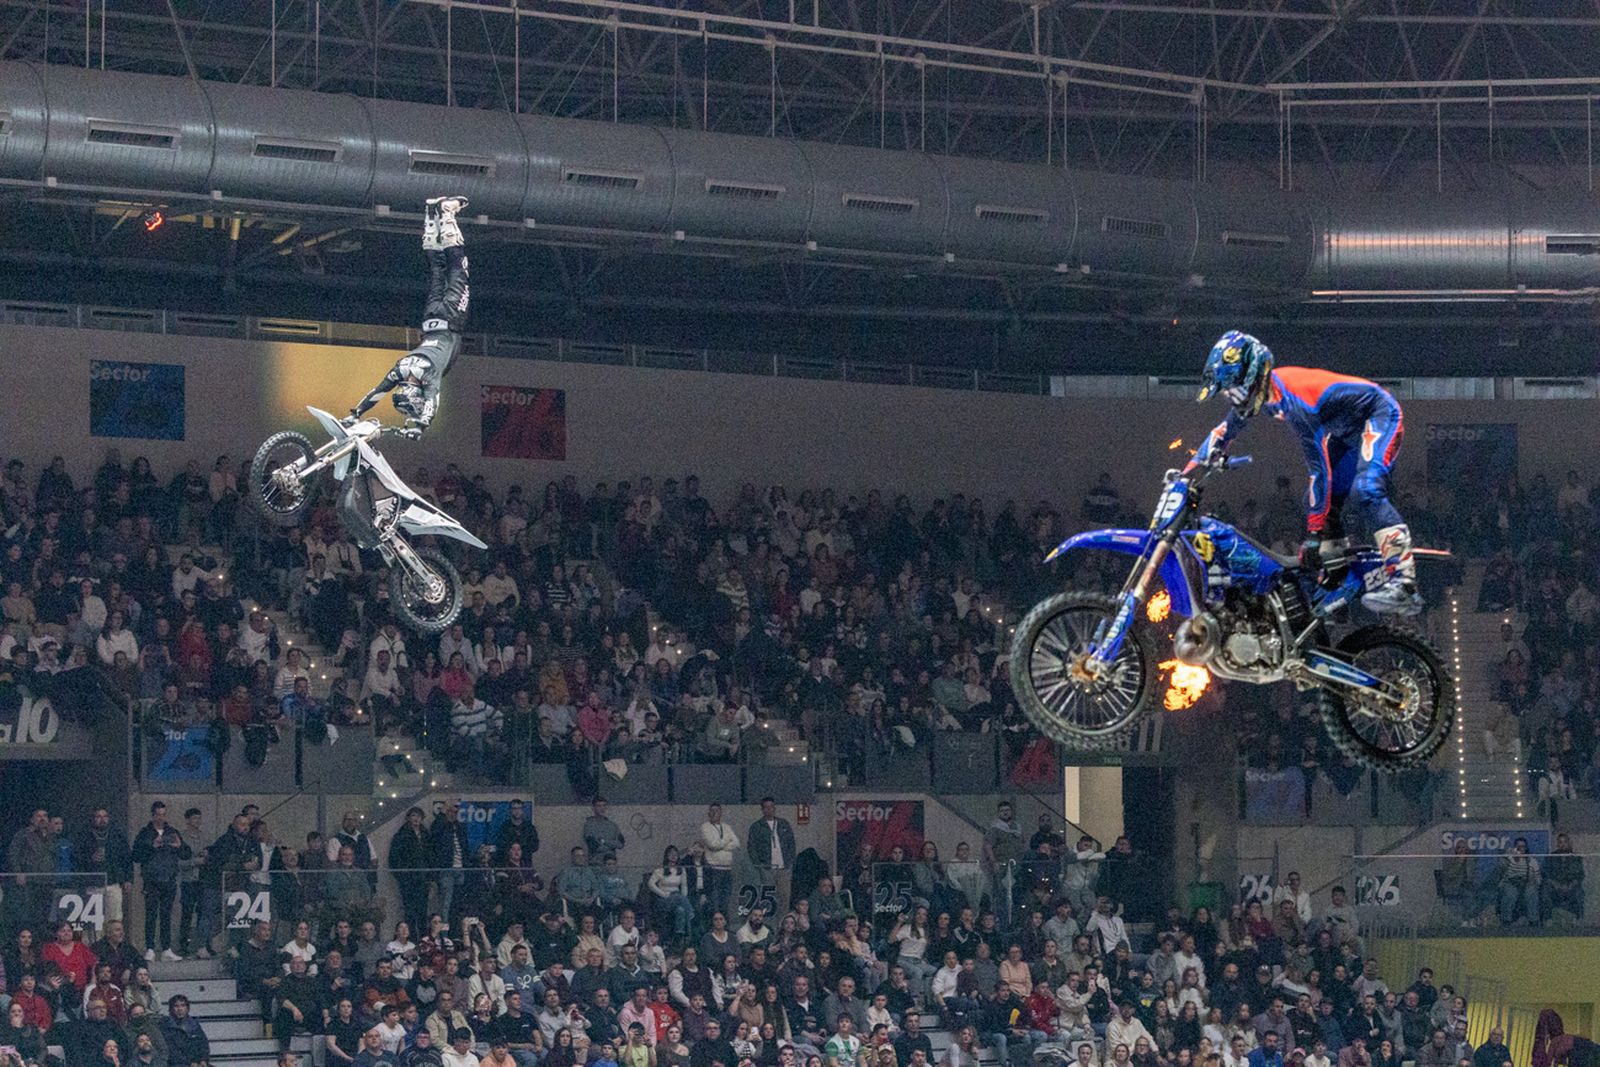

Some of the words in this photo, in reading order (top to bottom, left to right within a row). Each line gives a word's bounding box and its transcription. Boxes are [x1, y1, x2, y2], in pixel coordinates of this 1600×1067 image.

[90, 361, 151, 381] Sector
[481, 386, 535, 406] Sector
[1425, 425, 1486, 441] Sector
[836, 802, 893, 821] Sector
[738, 884, 777, 917] 25
[874, 881, 913, 914] 25
[1240, 874, 1274, 906] 26
[1356, 875, 1400, 906] 26
[58, 893, 105, 931] 24
[227, 891, 272, 928] 24
[874, 902, 903, 913] Sector
